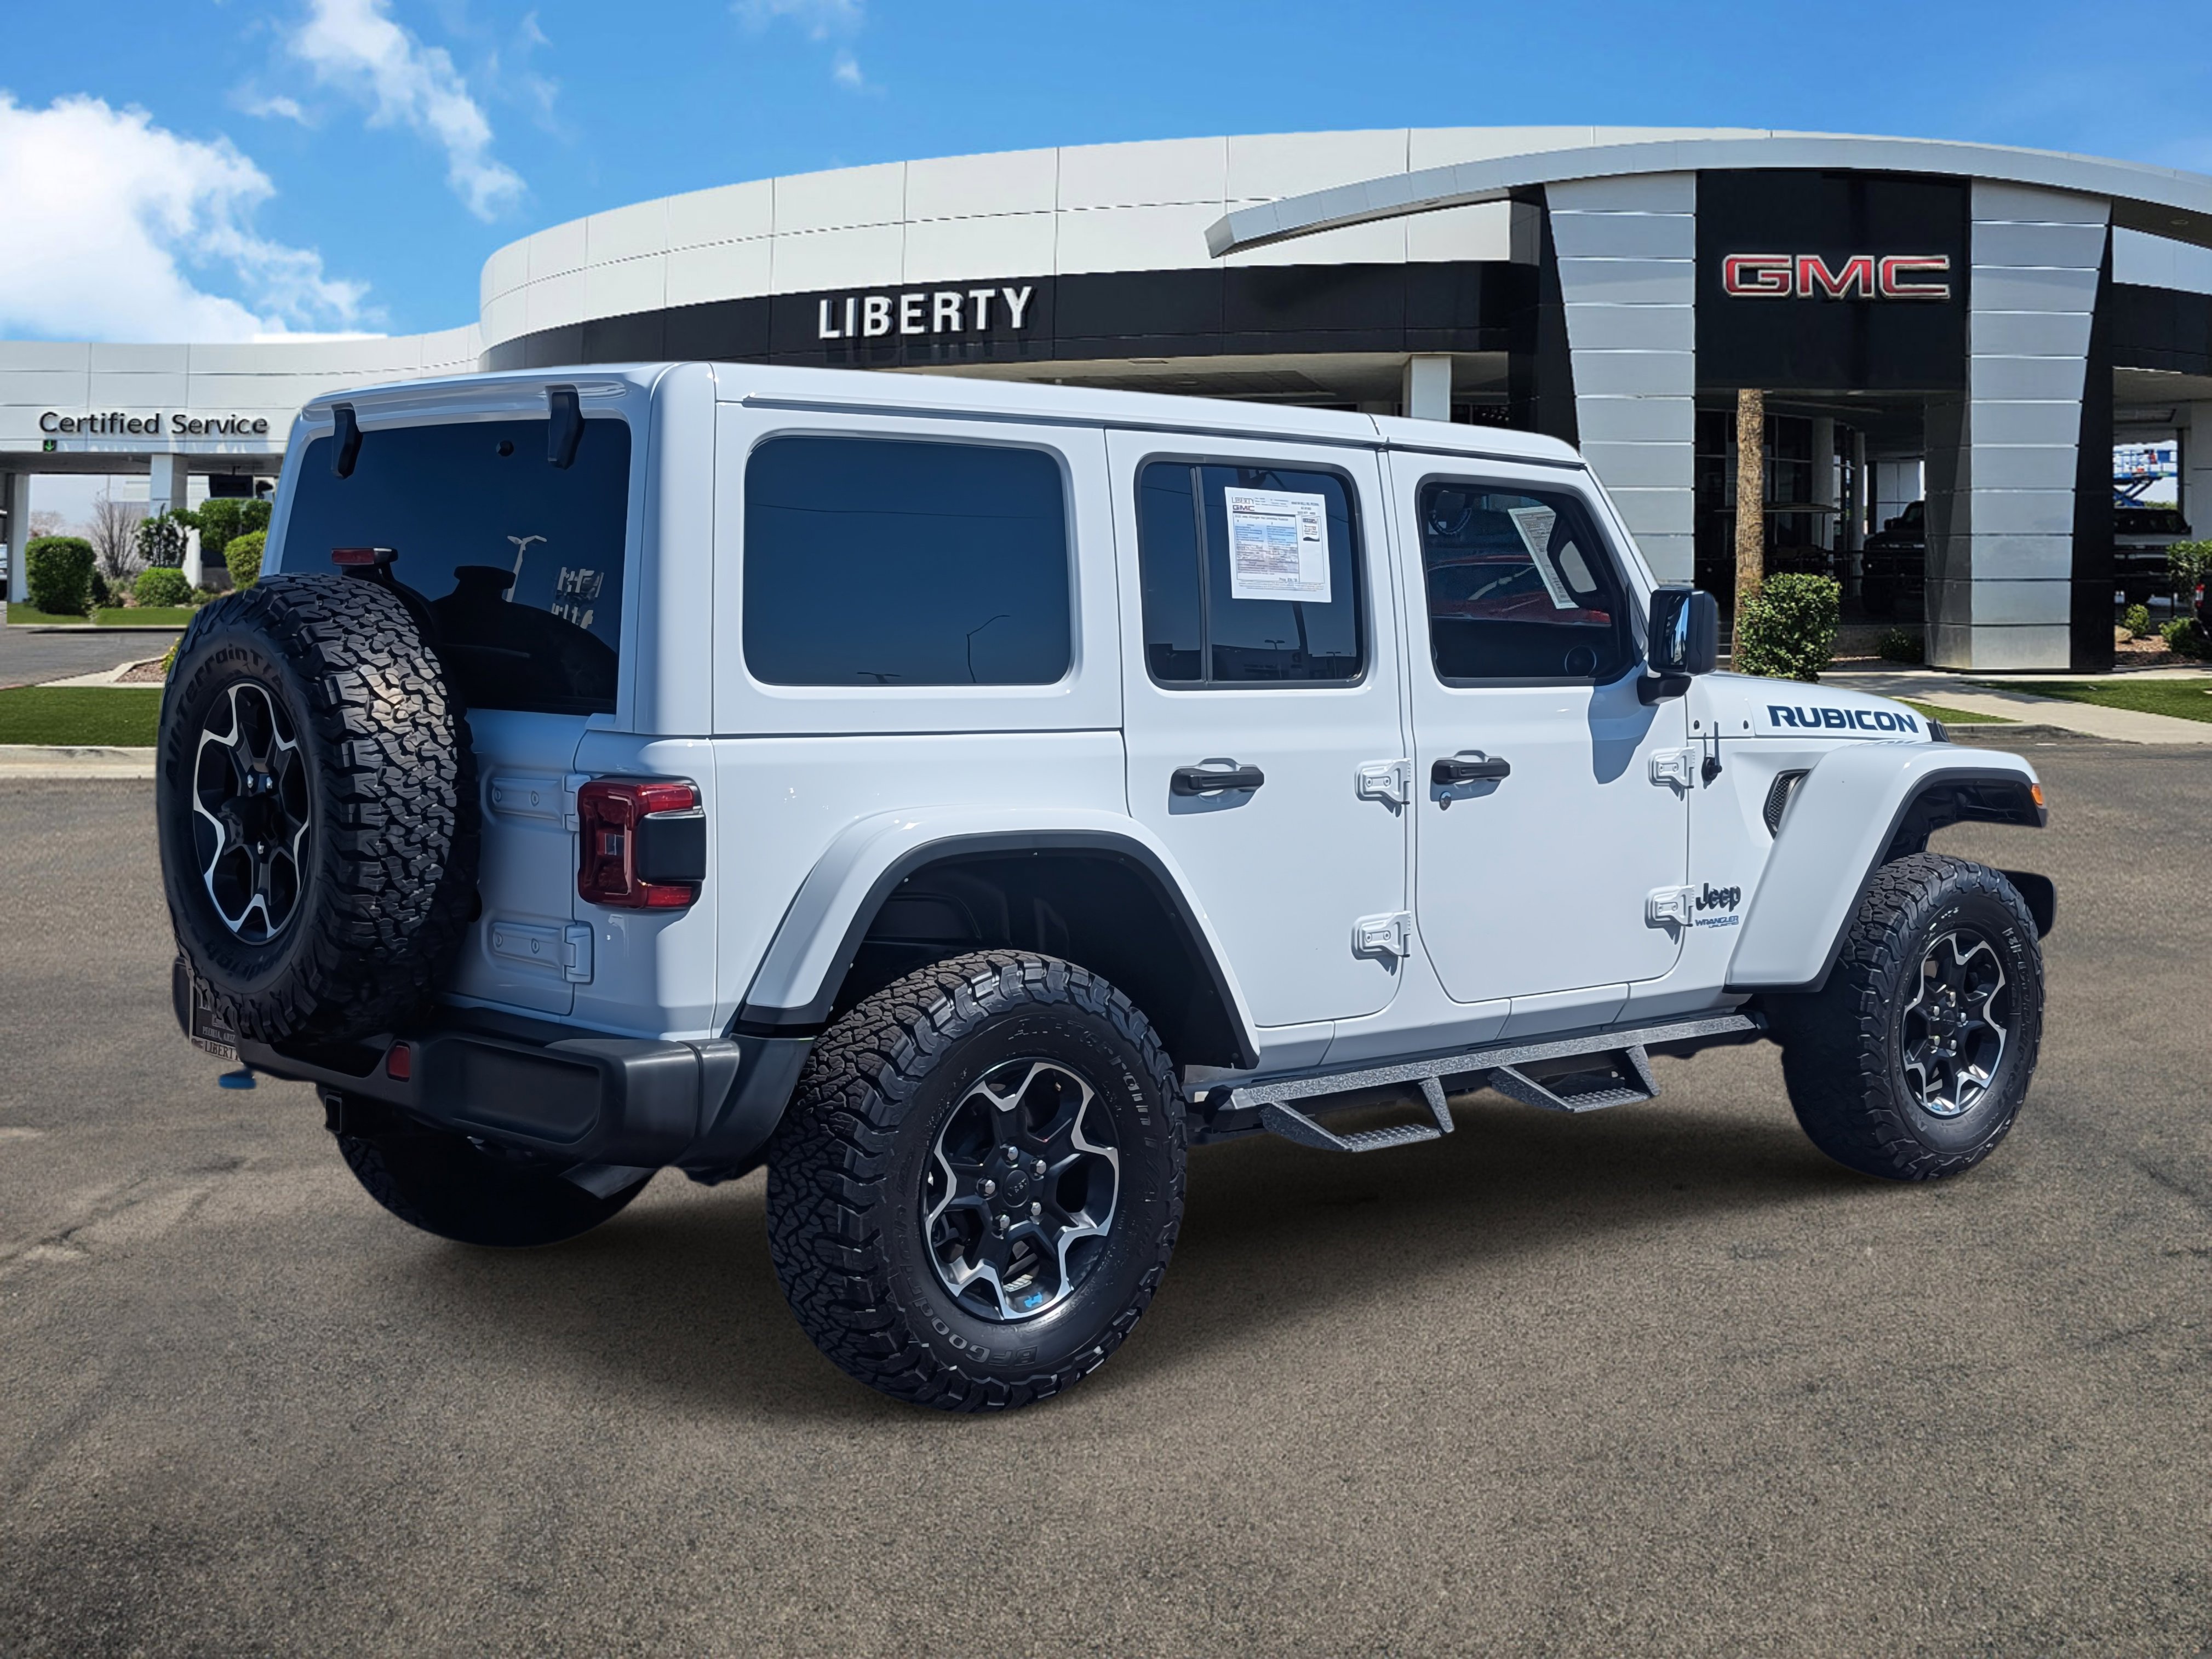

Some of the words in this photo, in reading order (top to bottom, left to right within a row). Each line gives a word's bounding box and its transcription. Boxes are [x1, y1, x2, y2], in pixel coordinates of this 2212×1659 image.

[1722, 254, 1950, 299] GMC
[818, 285, 1033, 340] LIBERTY
[39, 411, 161, 435] Certified
[171, 414, 268, 435] Service
[1766, 705, 1919, 733] RUBICON
[1695, 882, 1741, 912] Jeep
[205, 1041, 238, 1060] LIBERT
